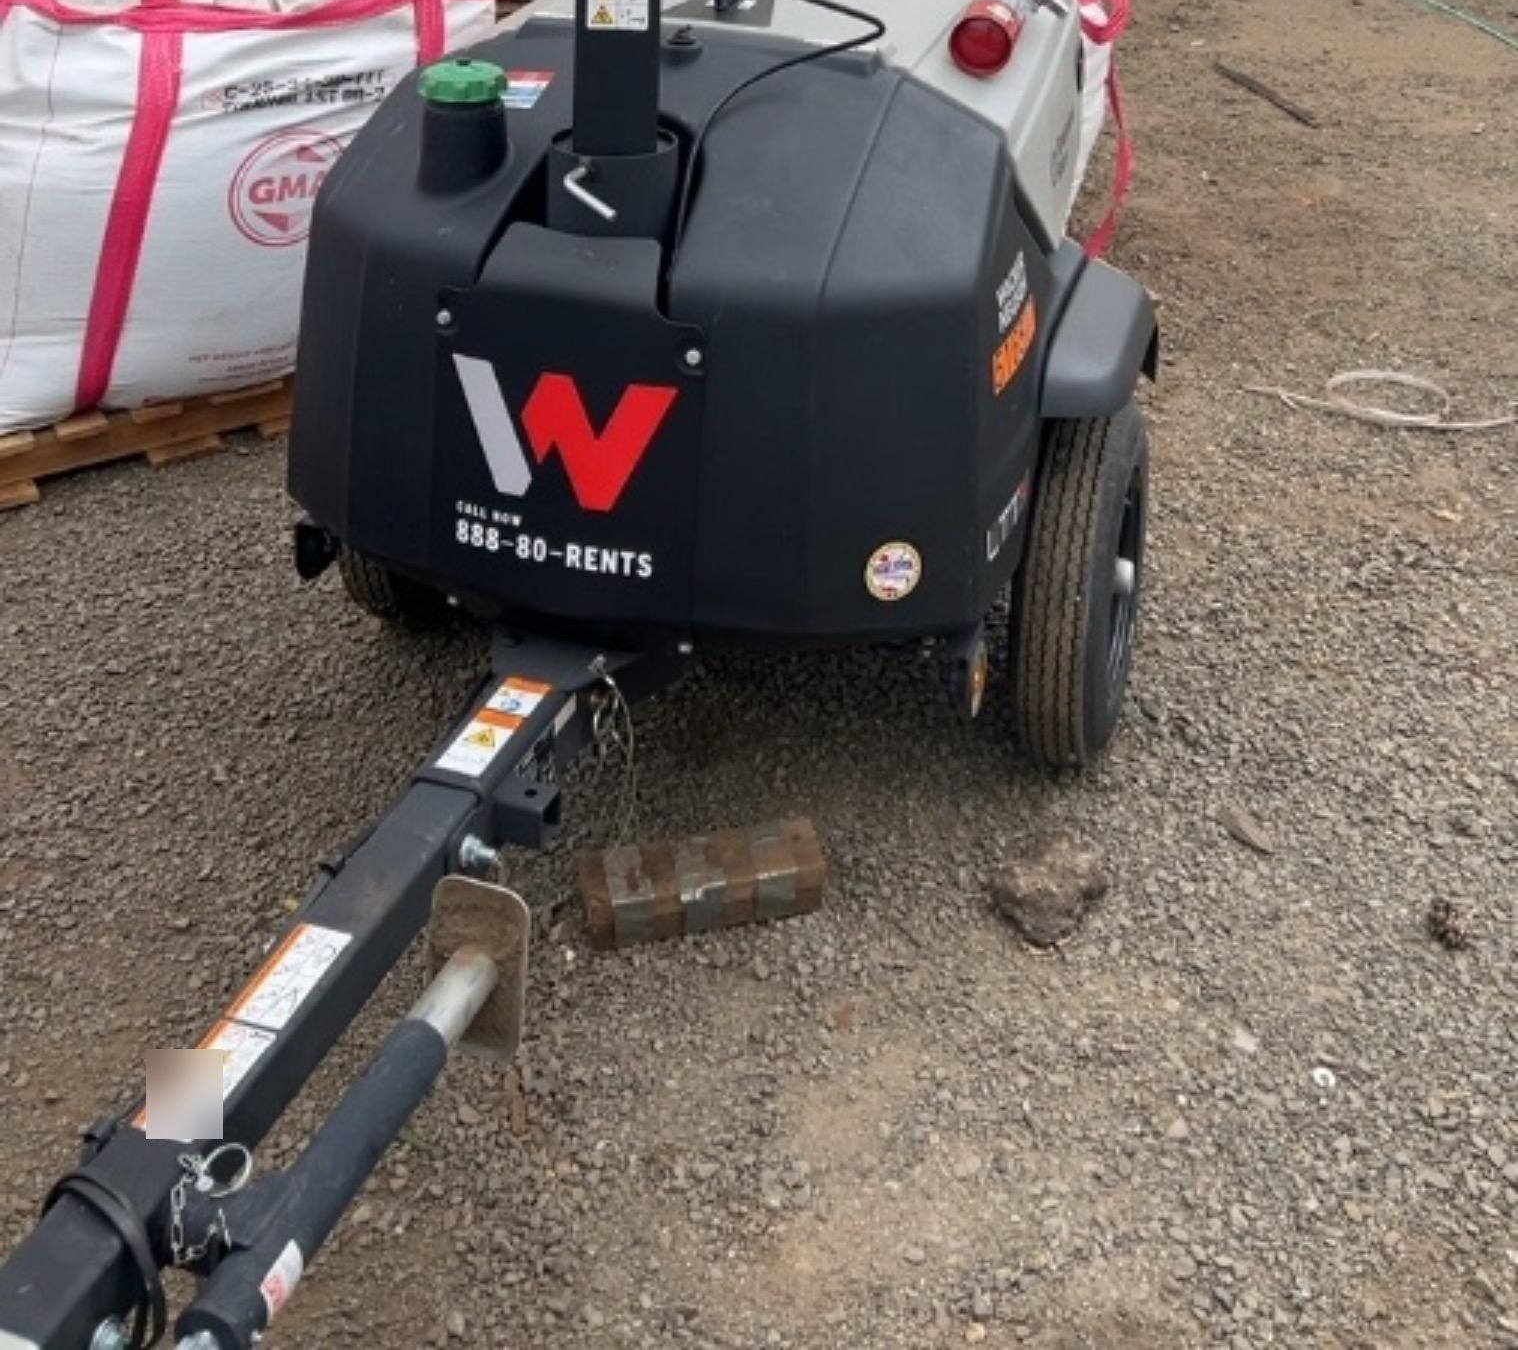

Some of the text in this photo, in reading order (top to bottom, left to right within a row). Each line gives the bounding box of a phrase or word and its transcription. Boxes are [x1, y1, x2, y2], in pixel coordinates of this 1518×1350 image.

[455, 499, 523, 527] CALL NOW
[455, 517, 653, 579] 888-80-RENTS
